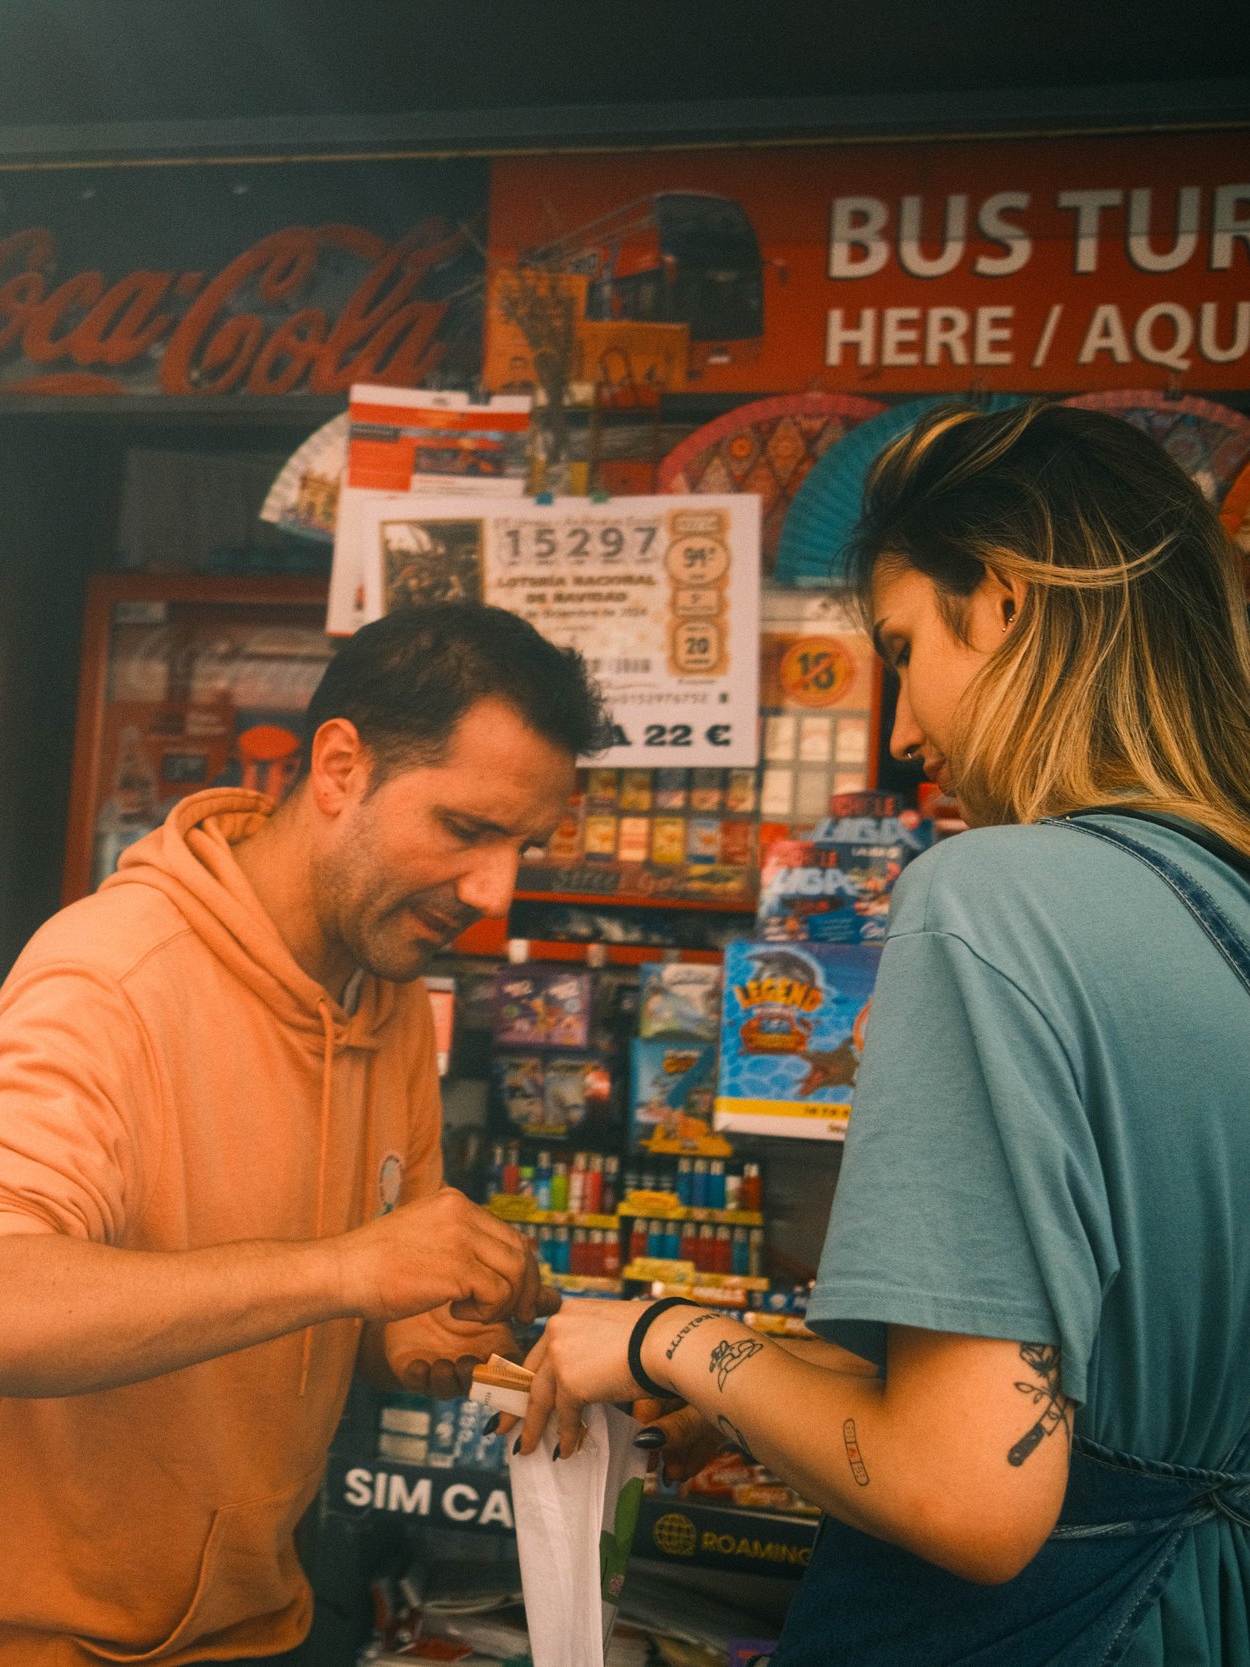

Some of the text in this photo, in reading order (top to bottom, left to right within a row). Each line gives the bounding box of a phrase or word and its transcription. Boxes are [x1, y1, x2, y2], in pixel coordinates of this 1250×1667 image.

[828, 183, 1250, 280] BUS TUR
[824, 305, 1016, 368] HERE
[1077, 301, 1250, 372] AQU
[505, 527, 659, 559] 15297
[643, 723, 693, 747] 22
[704, 723, 733, 747] €
[344, 1467, 515, 1529] SIM CA
